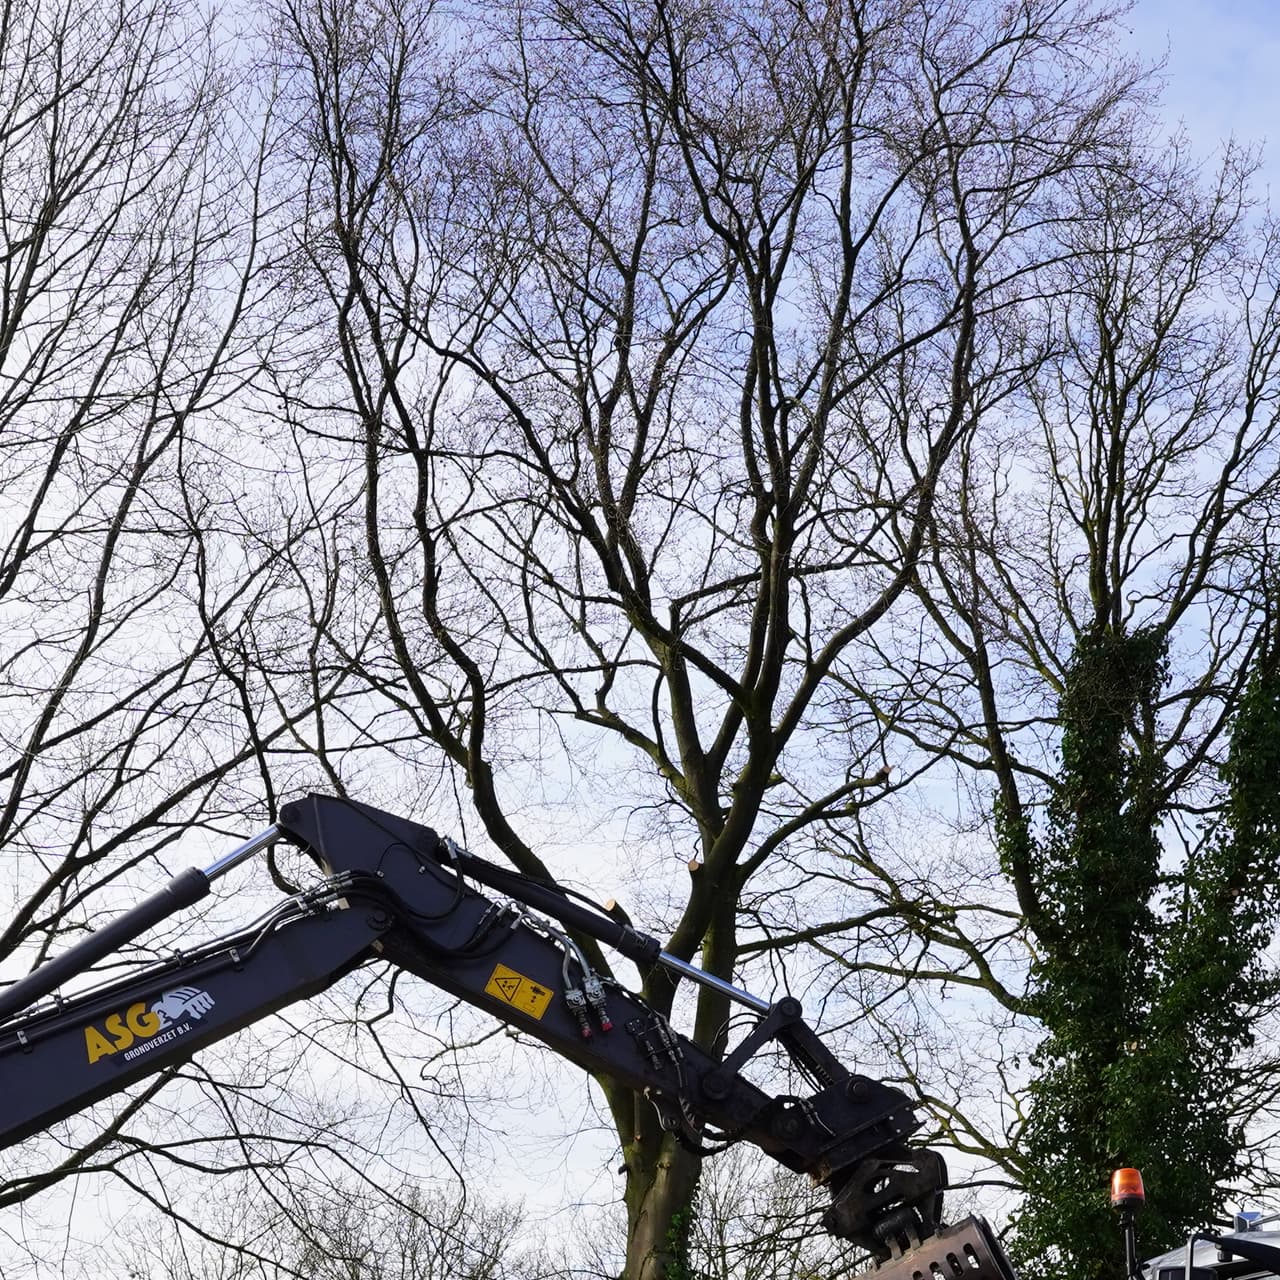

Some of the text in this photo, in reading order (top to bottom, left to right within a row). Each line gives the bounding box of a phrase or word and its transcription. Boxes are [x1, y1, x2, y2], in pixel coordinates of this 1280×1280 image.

[85, 1002, 161, 1064] ASG
[124, 1022, 193, 1061] GRONDVERZET B.V.
